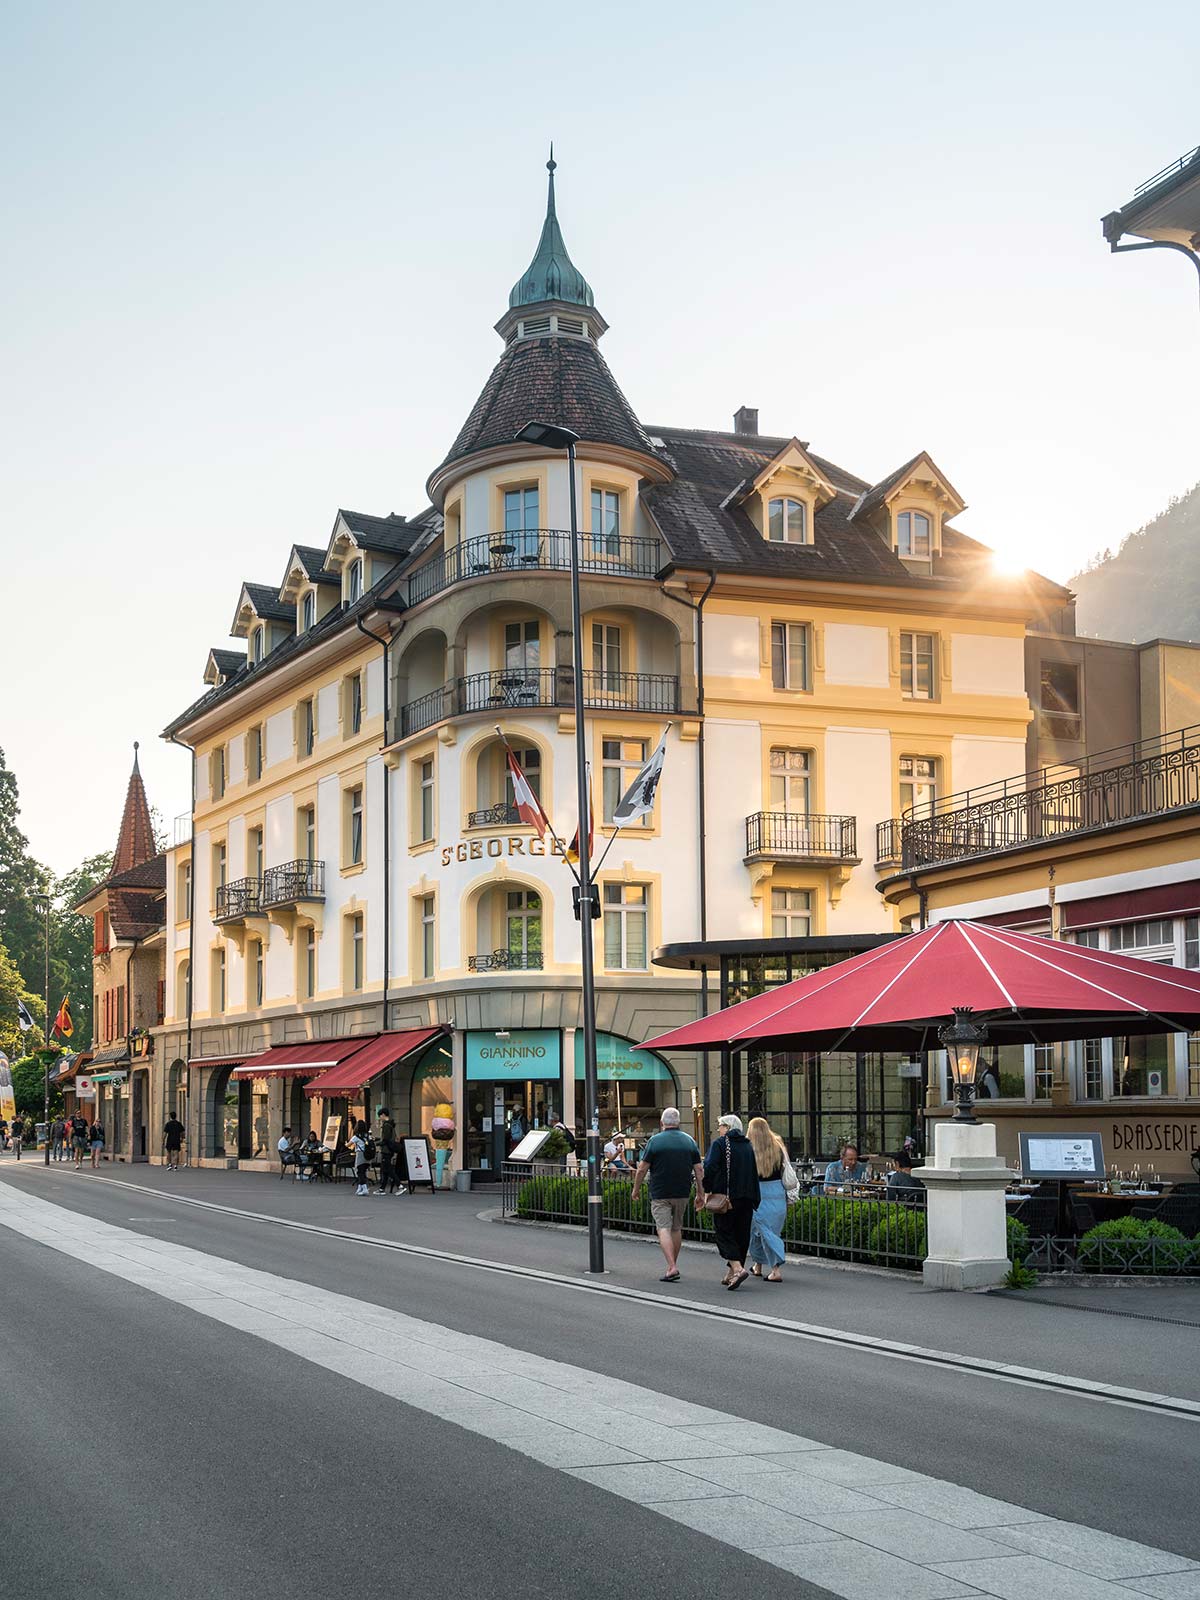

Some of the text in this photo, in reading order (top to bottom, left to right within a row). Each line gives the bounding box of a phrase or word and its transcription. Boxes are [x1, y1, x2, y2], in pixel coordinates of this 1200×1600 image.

[455, 837, 567, 862] GEORGE
[480, 1046, 546, 1059] GIANNINO
[1112, 1124, 1199, 1151] BRASSERIE
